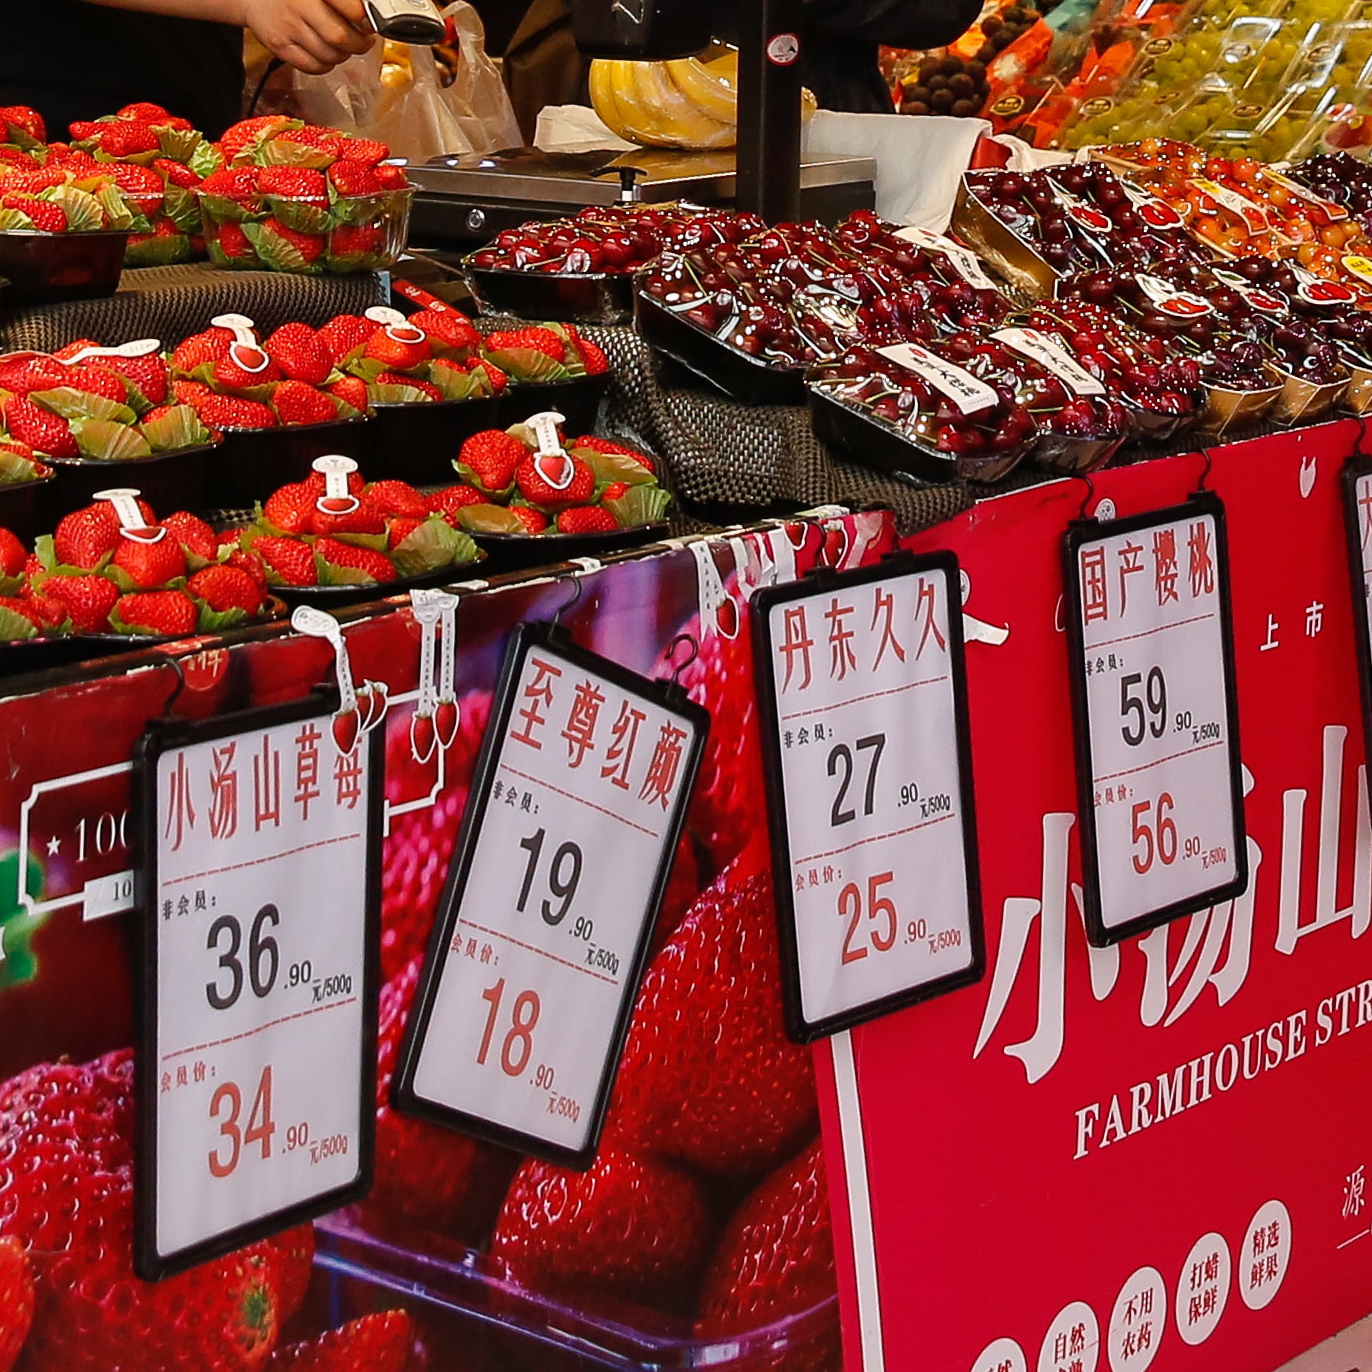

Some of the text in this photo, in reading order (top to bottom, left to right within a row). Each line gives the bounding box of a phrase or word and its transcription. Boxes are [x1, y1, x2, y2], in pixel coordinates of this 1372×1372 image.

[1080, 522, 1215, 626] 国产樱桃
[778, 577, 947, 695] 丹东久久
[509, 657, 688, 814] 至尊红颜
[1073, 1012, 1307, 1161] FARMHOUSE
[1252, 1220, 1280, 1258] 精选
[1190, 1252, 1220, 1292] 打蜡
[1250, 1253, 1279, 1290] 鲜果
[1123, 1287, 1154, 1326] 不用
[1187, 1285, 1218, 1327] 保鲜
[1054, 1322, 1086, 1364] 自然
[1121, 1321, 1153, 1361] 农药
